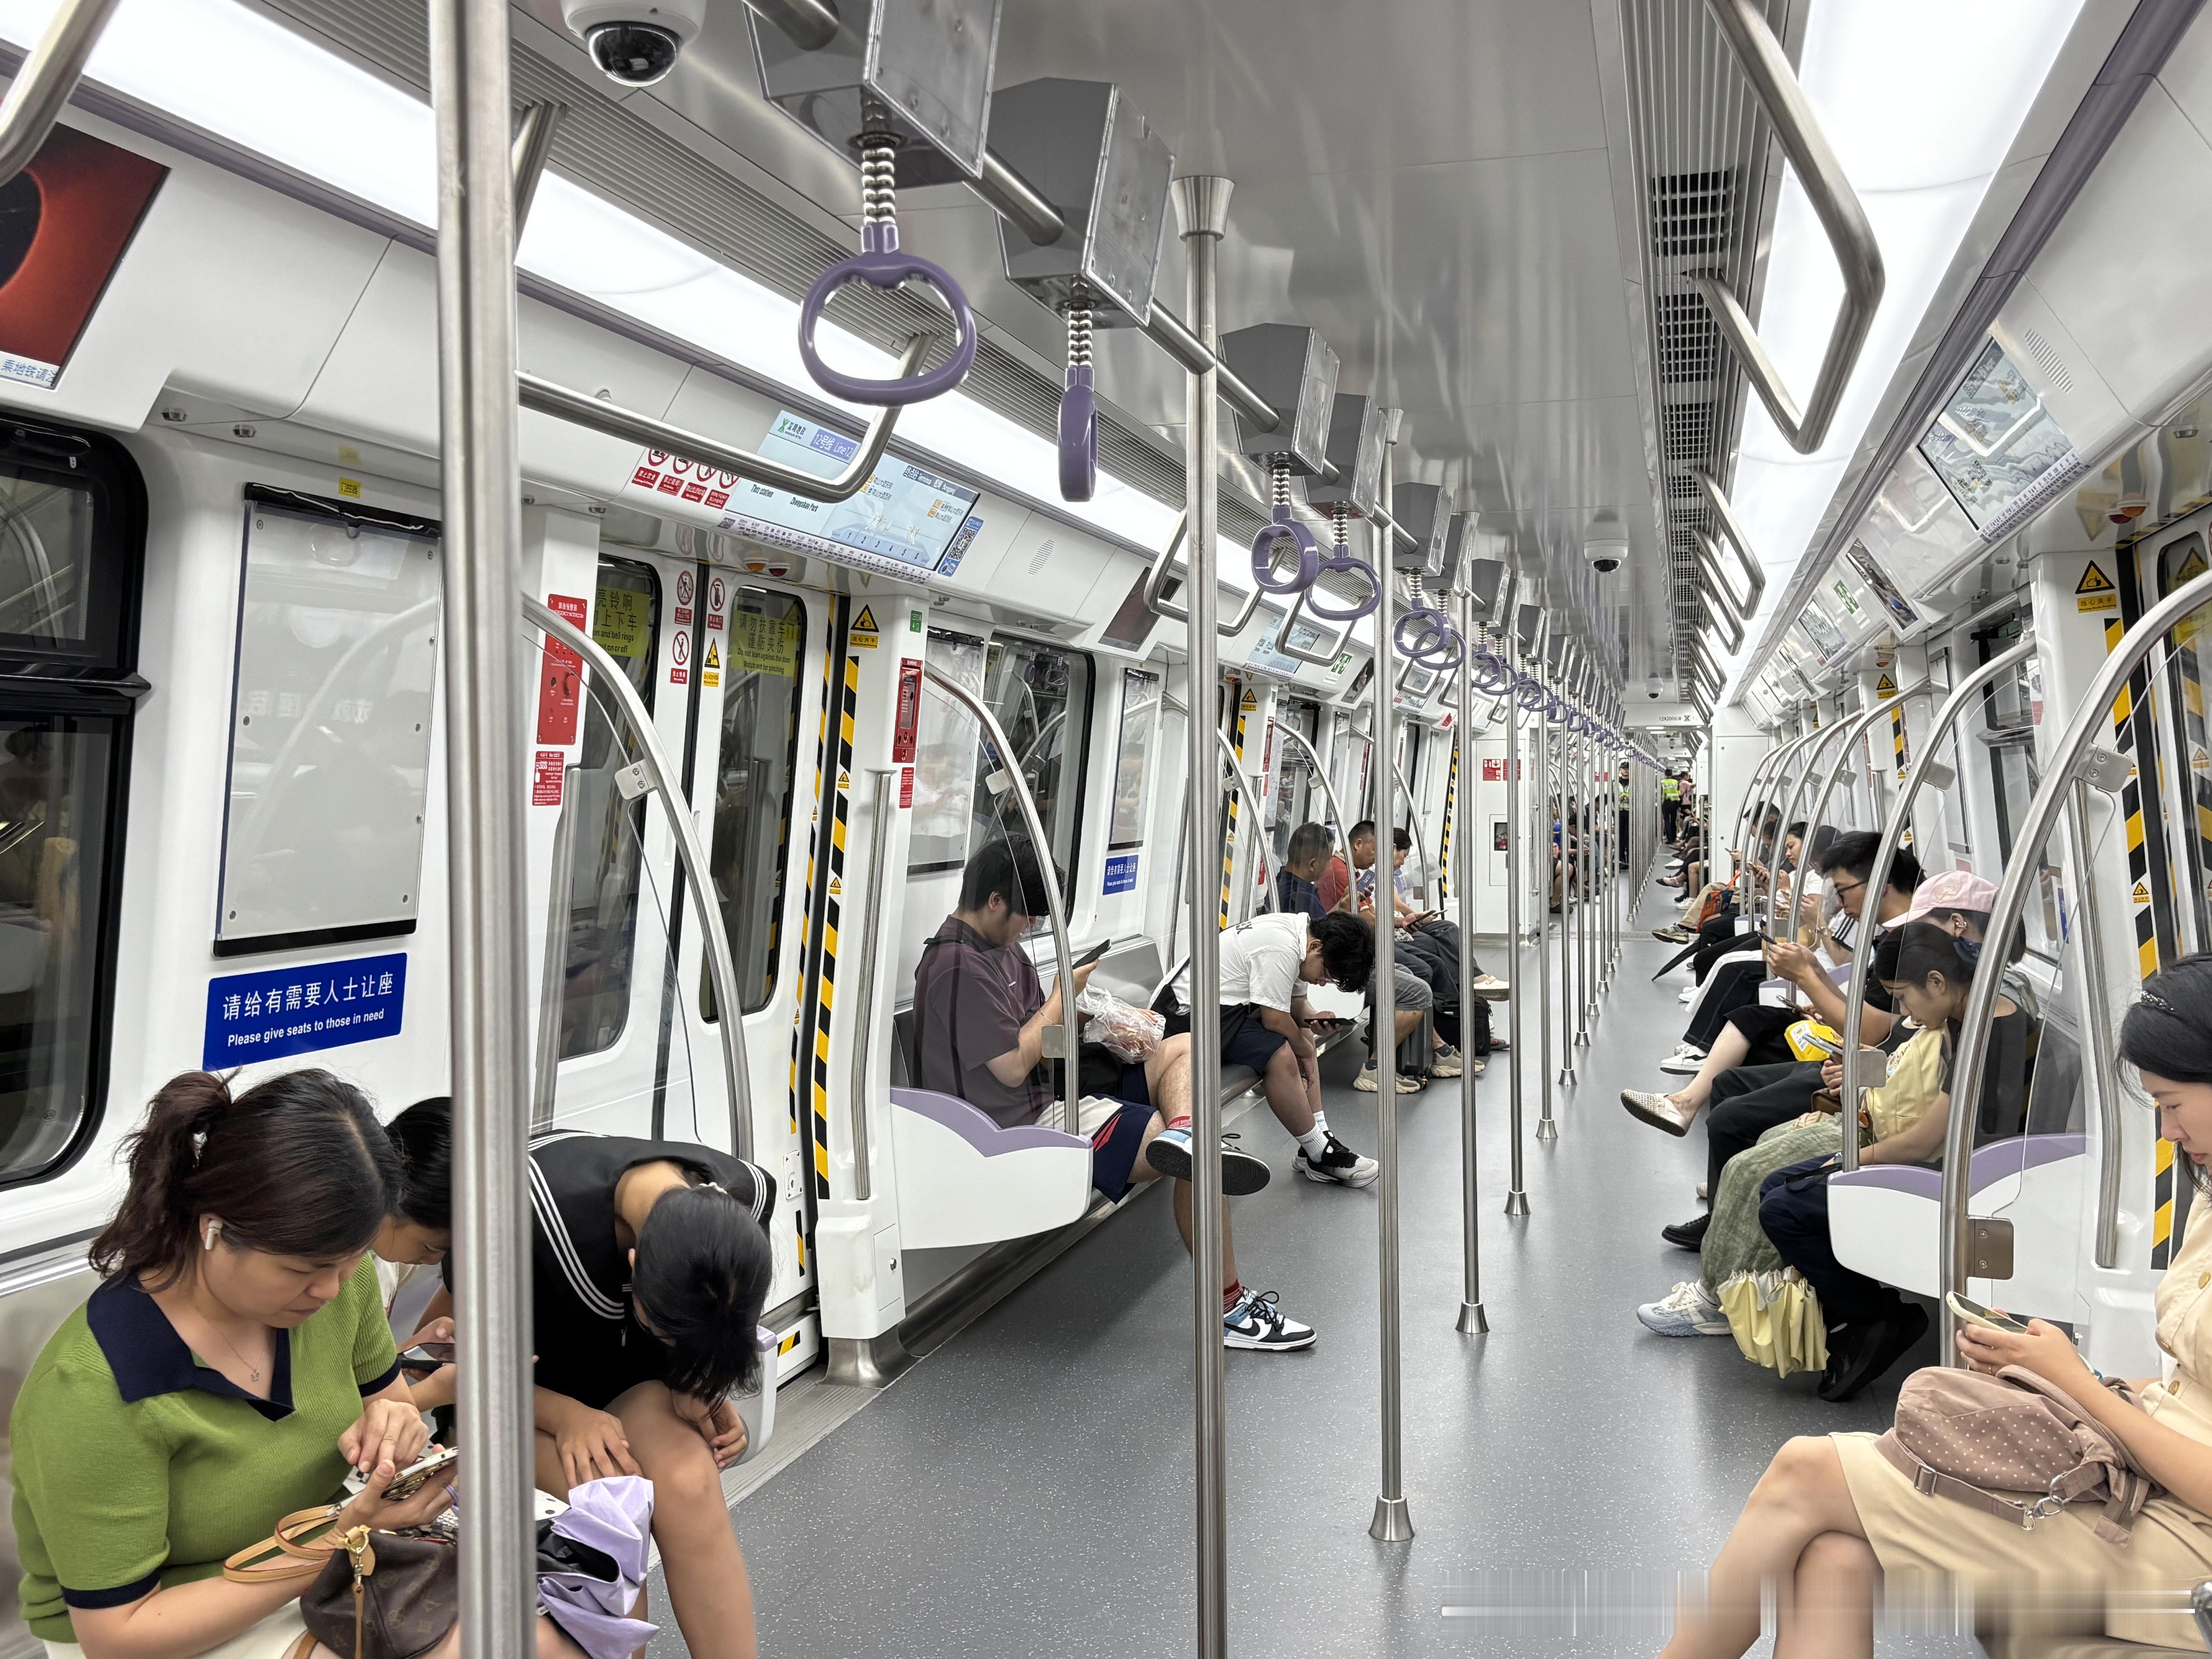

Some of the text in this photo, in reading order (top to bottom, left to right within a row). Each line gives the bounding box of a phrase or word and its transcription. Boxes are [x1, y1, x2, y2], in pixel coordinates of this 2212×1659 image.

[813, 434, 835, 452] 12号线
[750, 484, 774, 498] This station
[597, 589, 632, 611] 亮铃响
[622, 632, 634, 642] rings
[223, 972, 393, 1021] 请给有需要人士让座
[228, 1008, 384, 1047] Please give seats to those in need
